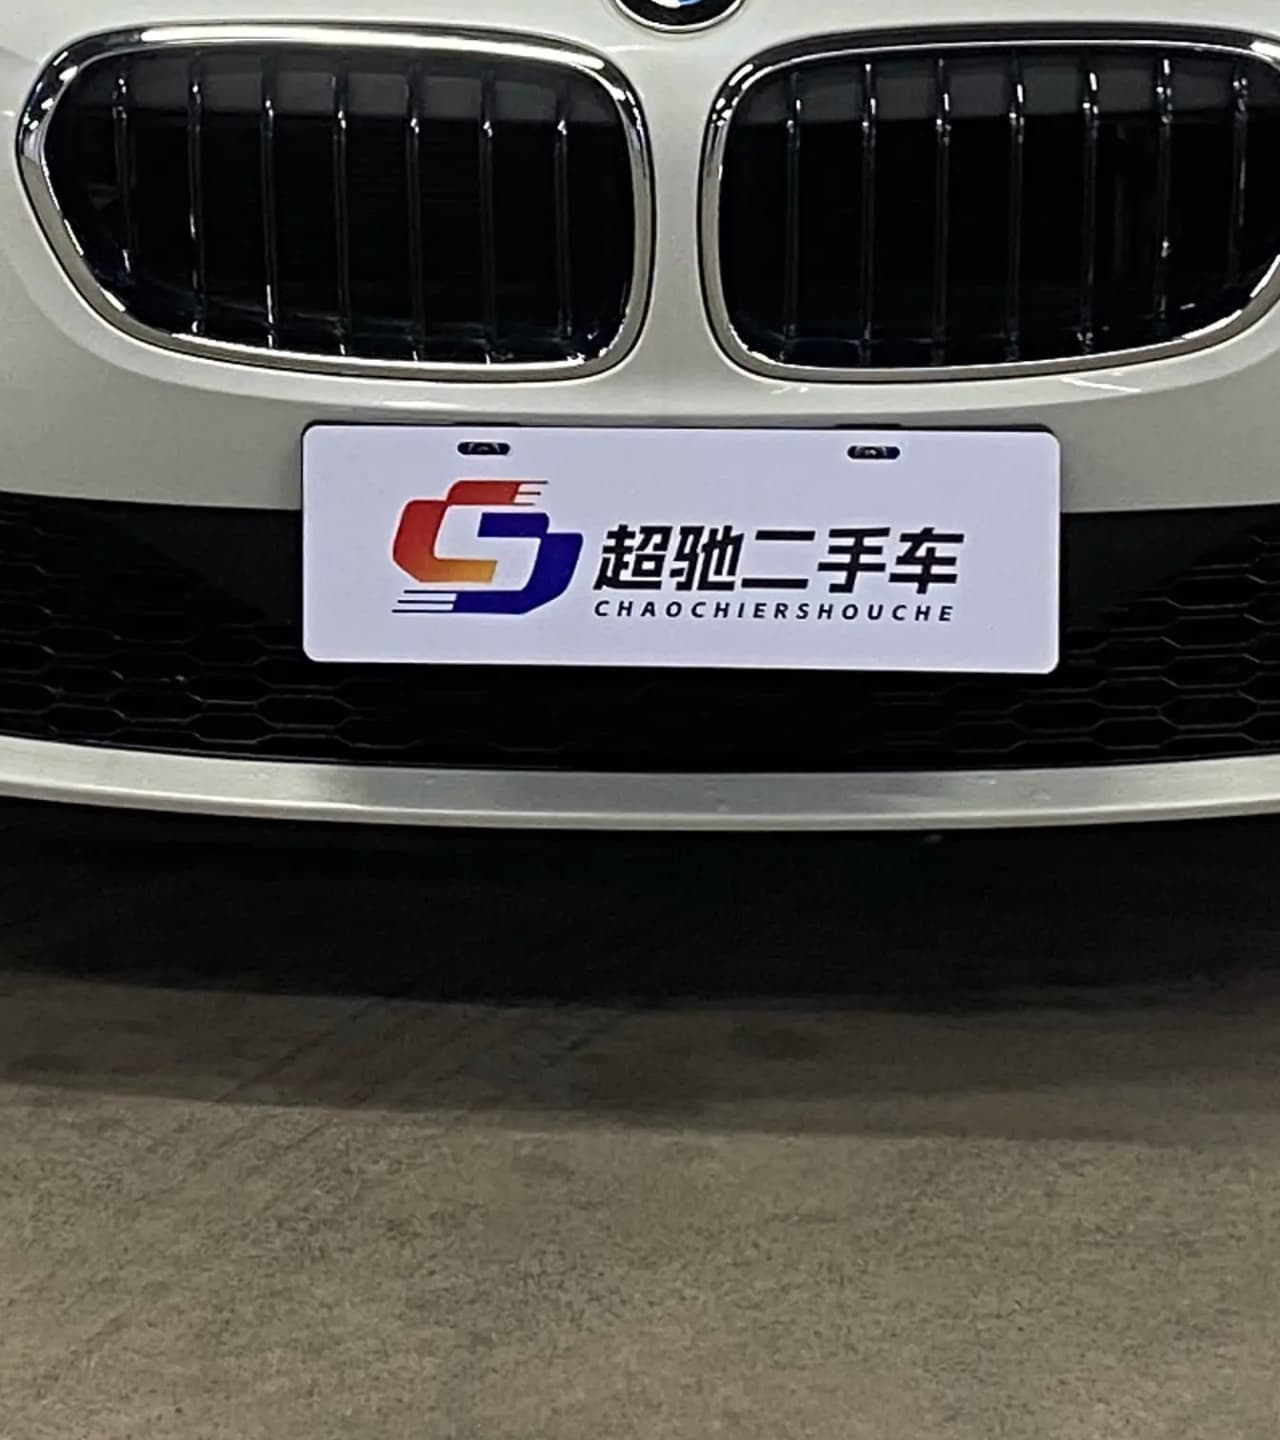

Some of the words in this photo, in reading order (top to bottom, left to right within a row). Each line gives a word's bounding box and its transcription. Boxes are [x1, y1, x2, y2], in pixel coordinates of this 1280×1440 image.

[593, 524, 964, 594] 超驰二手车
[593, 600, 953, 622] CHAOCHIERSHOUCHE
